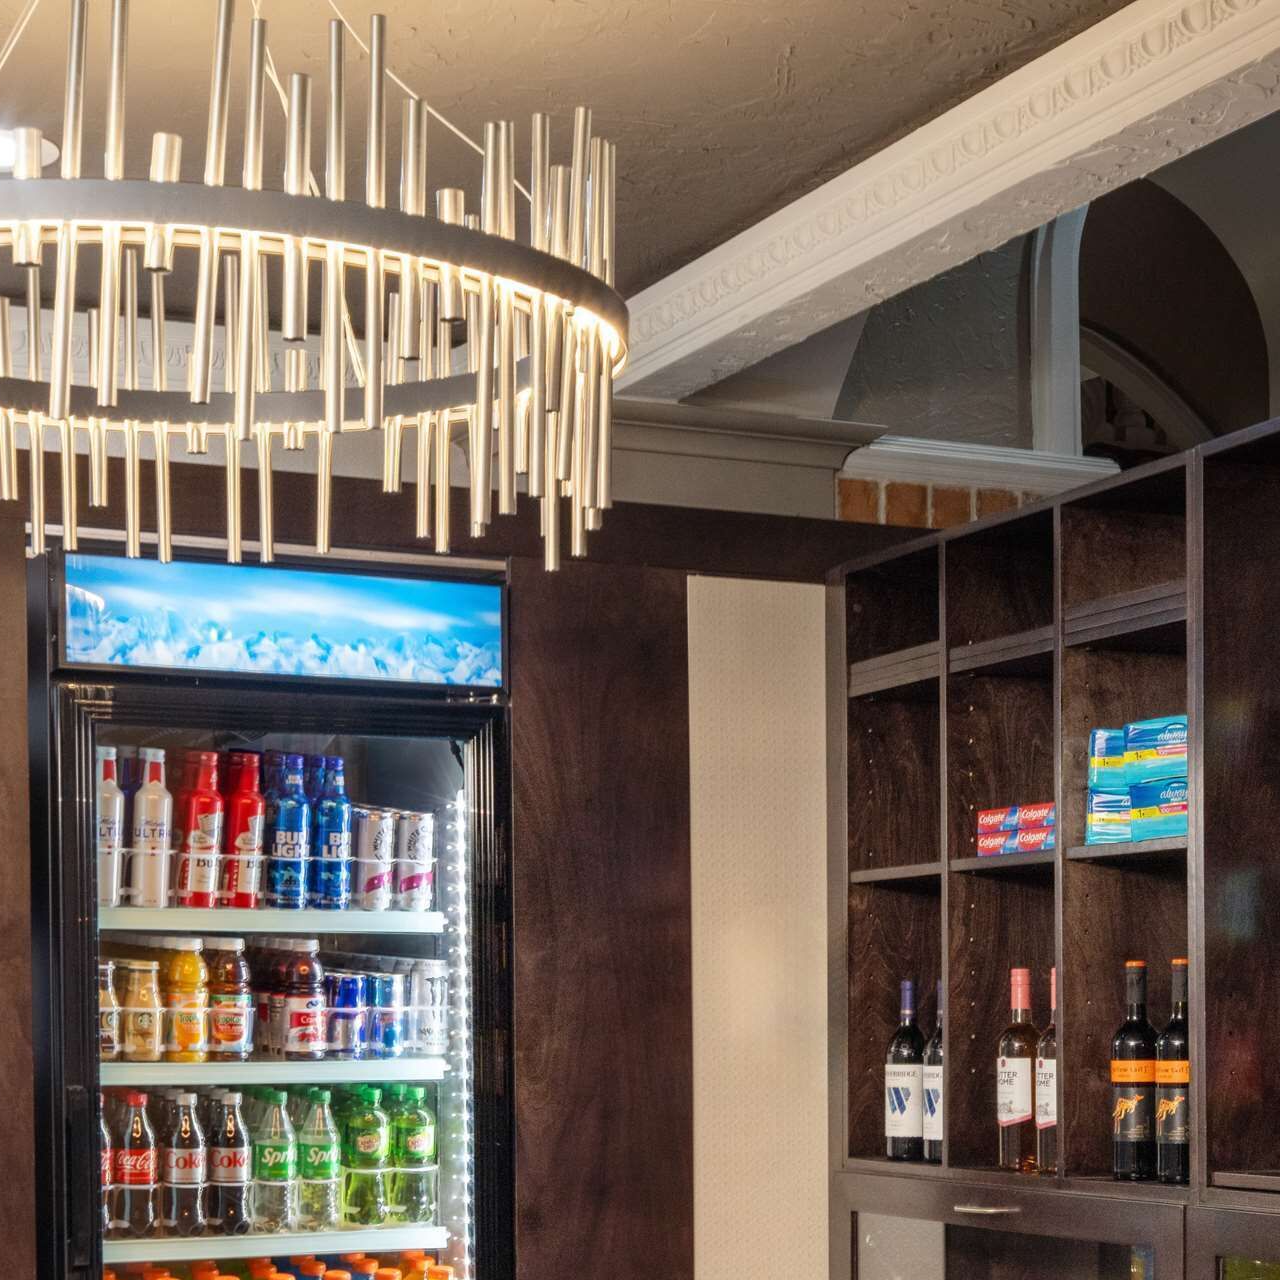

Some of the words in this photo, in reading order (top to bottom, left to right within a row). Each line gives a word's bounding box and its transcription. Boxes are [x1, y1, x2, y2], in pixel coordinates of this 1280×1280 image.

[978, 812, 1006, 825] Colgate
[1021, 807, 1049, 819] Colgate
[978, 836, 1006, 848] Colgate
[1019, 830, 1047, 842] Colgate
